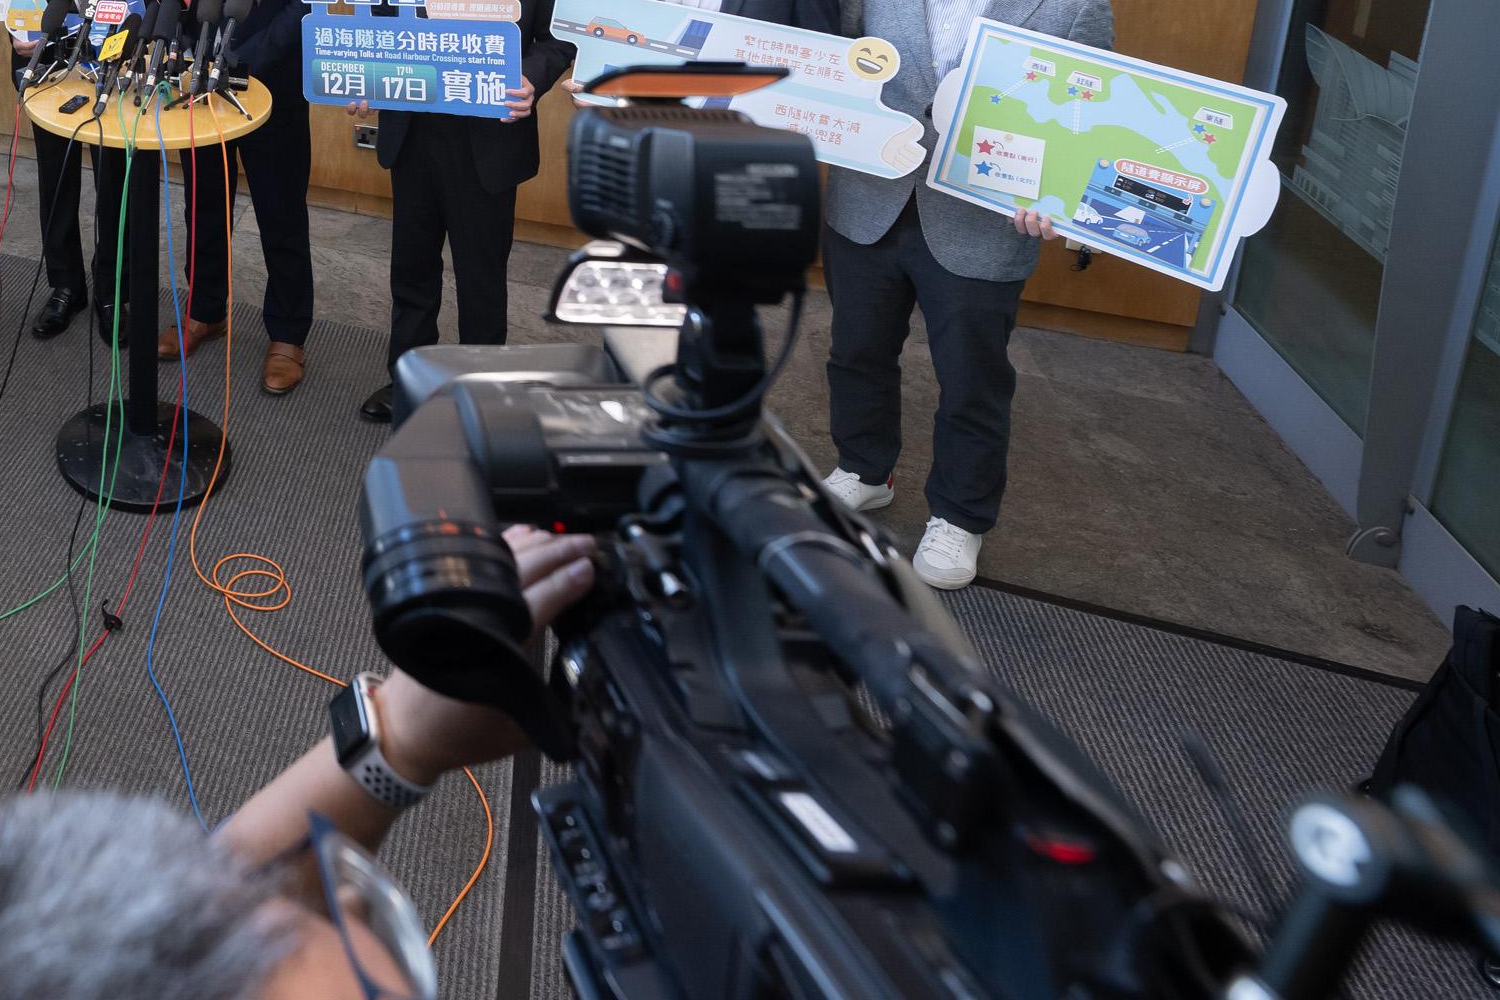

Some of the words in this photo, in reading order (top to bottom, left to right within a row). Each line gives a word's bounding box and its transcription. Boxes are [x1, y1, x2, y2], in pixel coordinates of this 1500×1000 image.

[315, 27, 506, 56] 過海隧道分時段收費
[315, 47, 358, 59] Time-varying
[359, 49, 374, 58] Tolls
[375, 51, 383, 59] at
[384, 50, 402, 60] Road
[402, 51, 430, 62] Harbour
[431, 53, 467, 64] Crossings
[467, 56, 486, 65] start
[487, 57, 505, 66] from
[320, 61, 365, 73] DECEMBER
[396, 66, 414, 75] 17th
[321, 72, 366, 97] 12月
[382, 77, 427, 101] 17日
[442, 69, 507, 106] 實施
